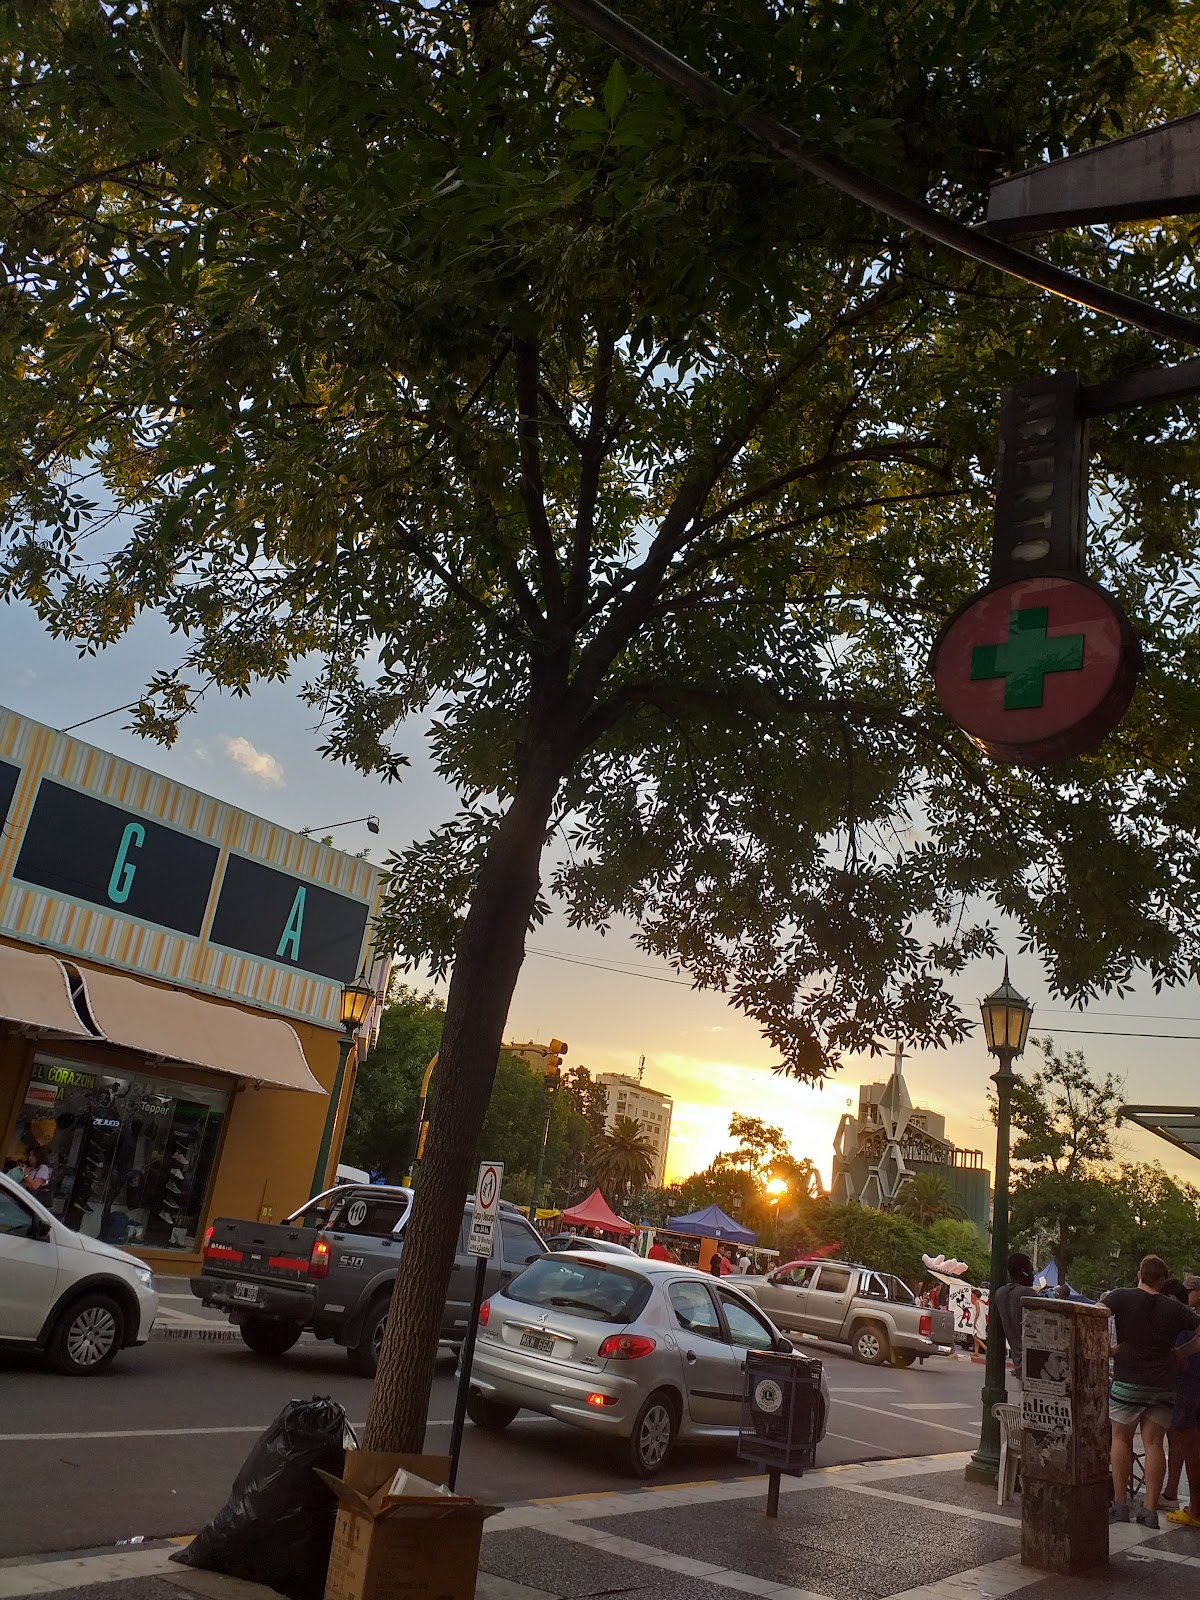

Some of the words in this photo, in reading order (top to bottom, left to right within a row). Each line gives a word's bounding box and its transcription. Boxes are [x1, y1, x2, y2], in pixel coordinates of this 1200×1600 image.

[107, 822, 146, 904] G
[275, 886, 307, 961] A
[47, 1066, 95, 1089] CORAZON
[141, 1100, 170, 1116] Topper
[350, 1205, 365, 1221] 110
[1023, 1398, 1070, 1417] alicia
[1022, 1412, 1071, 1428] eguren
